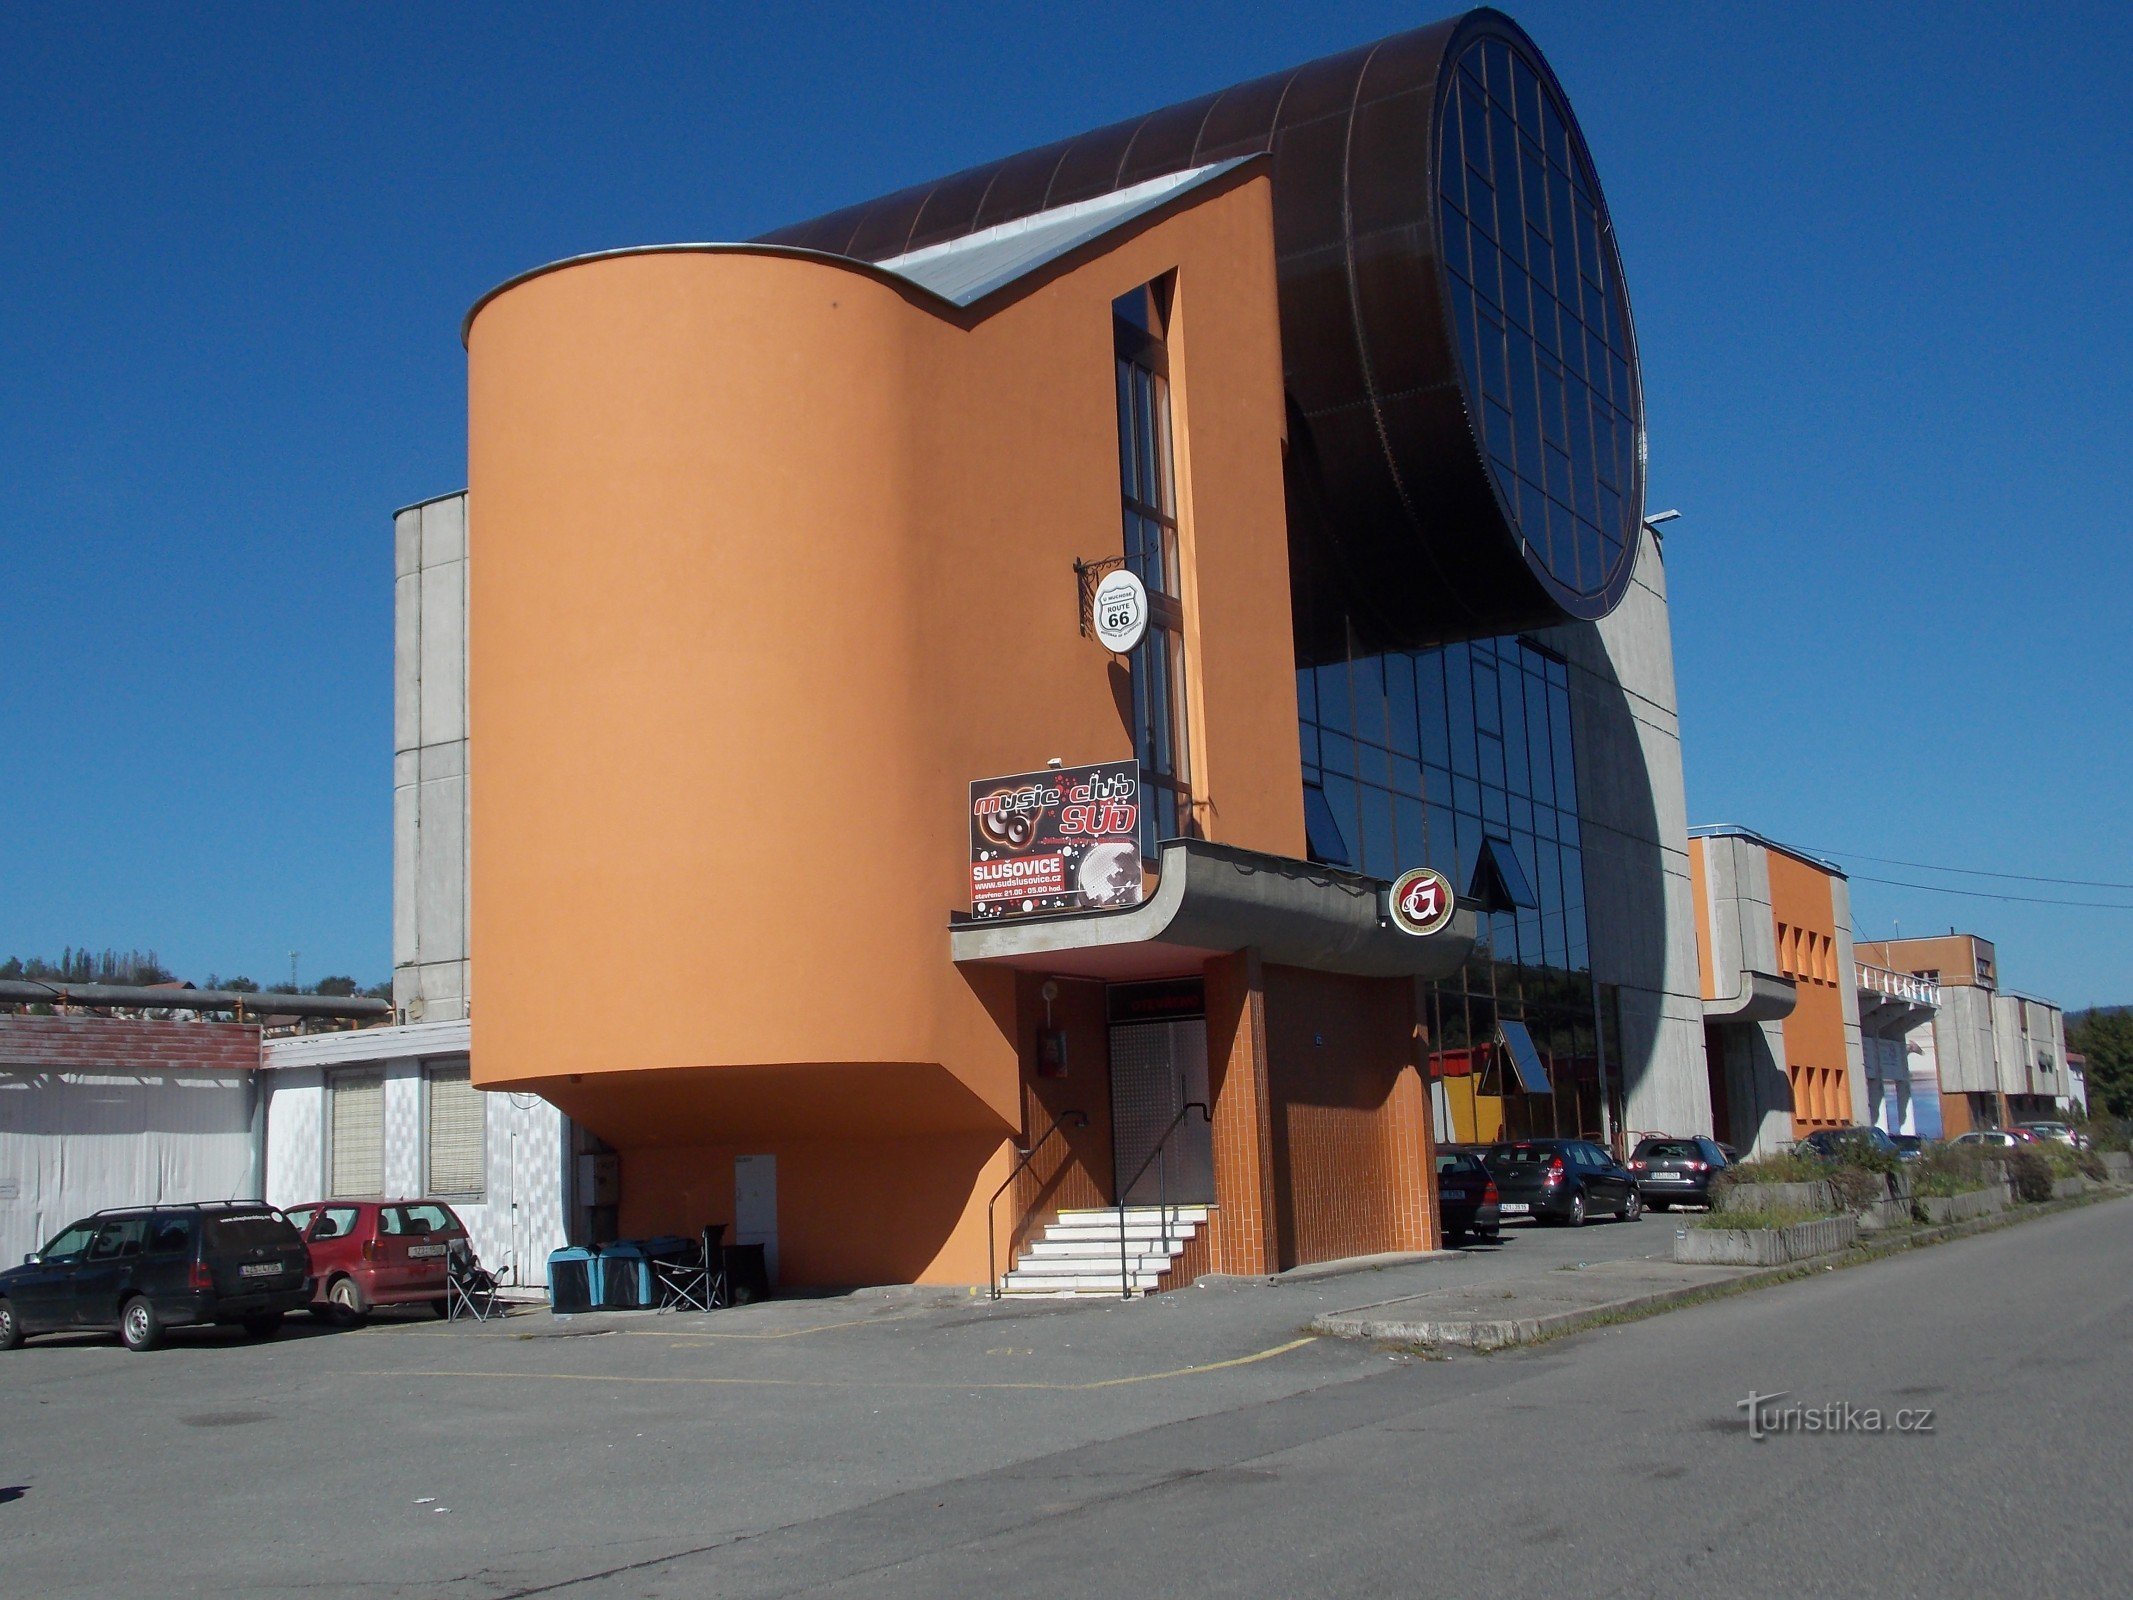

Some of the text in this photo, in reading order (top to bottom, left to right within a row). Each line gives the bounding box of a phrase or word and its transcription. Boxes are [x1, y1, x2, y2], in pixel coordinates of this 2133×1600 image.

[1107, 603, 1130, 613] ROUTE
[1108, 611, 1129, 627] 66
[974, 773, 1136, 816] music club
[1059, 804, 1137, 835] SUD
[974, 858, 1060, 881] SLUŠOVICE
[974, 875, 1061, 890] www.sudslusovice.cz
[1004, 888, 1023, 896] 21.00
[1027, 885, 1048, 894] 05.00
[1048, 884, 1063, 892] hod.
